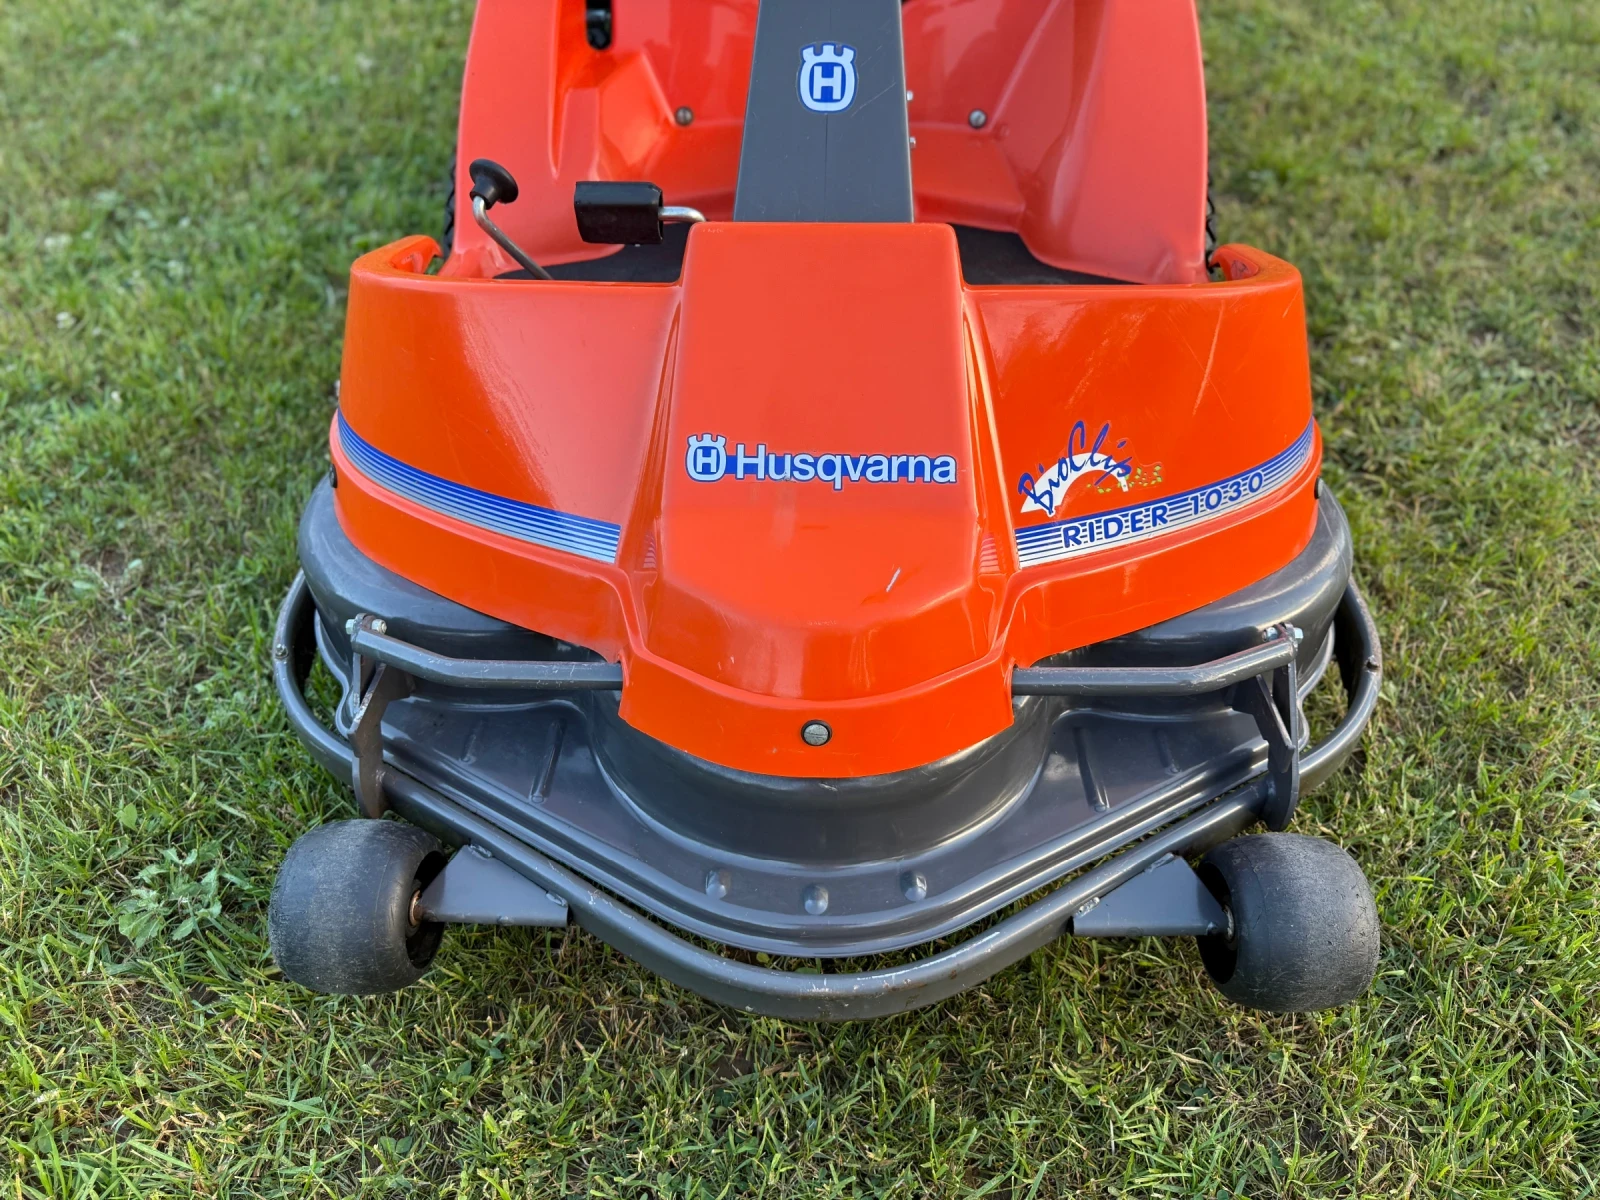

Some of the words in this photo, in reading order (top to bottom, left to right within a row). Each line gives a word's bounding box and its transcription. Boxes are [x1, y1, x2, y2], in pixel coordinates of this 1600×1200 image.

[812, 65, 843, 100] H
[736, 443, 957, 491] Husqvarna
[1062, 504, 1170, 549] RIDER
[1190, 471, 1264, 515] 1030
